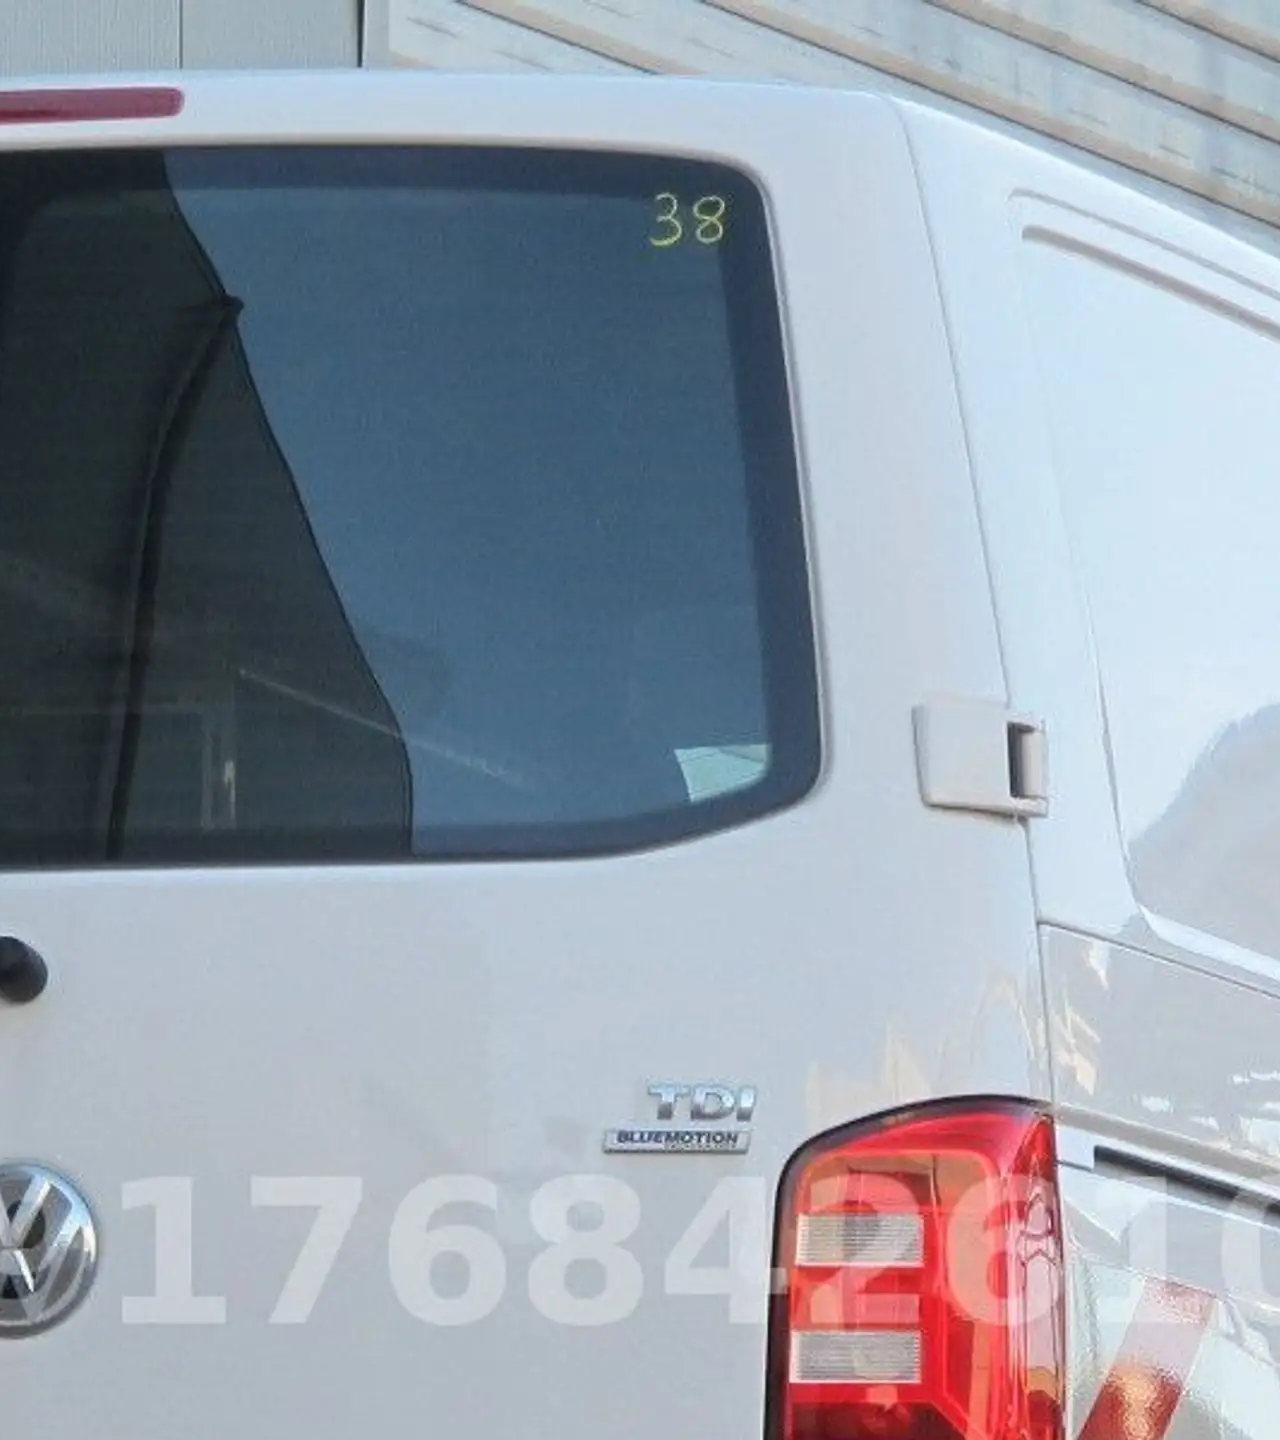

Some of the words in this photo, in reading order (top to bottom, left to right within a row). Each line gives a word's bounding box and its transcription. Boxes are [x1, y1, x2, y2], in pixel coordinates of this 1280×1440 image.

[650, 192, 726, 247] 38
[647, 1084, 758, 1122] TDI
[616, 1130, 739, 1145] BLUEMOTION
